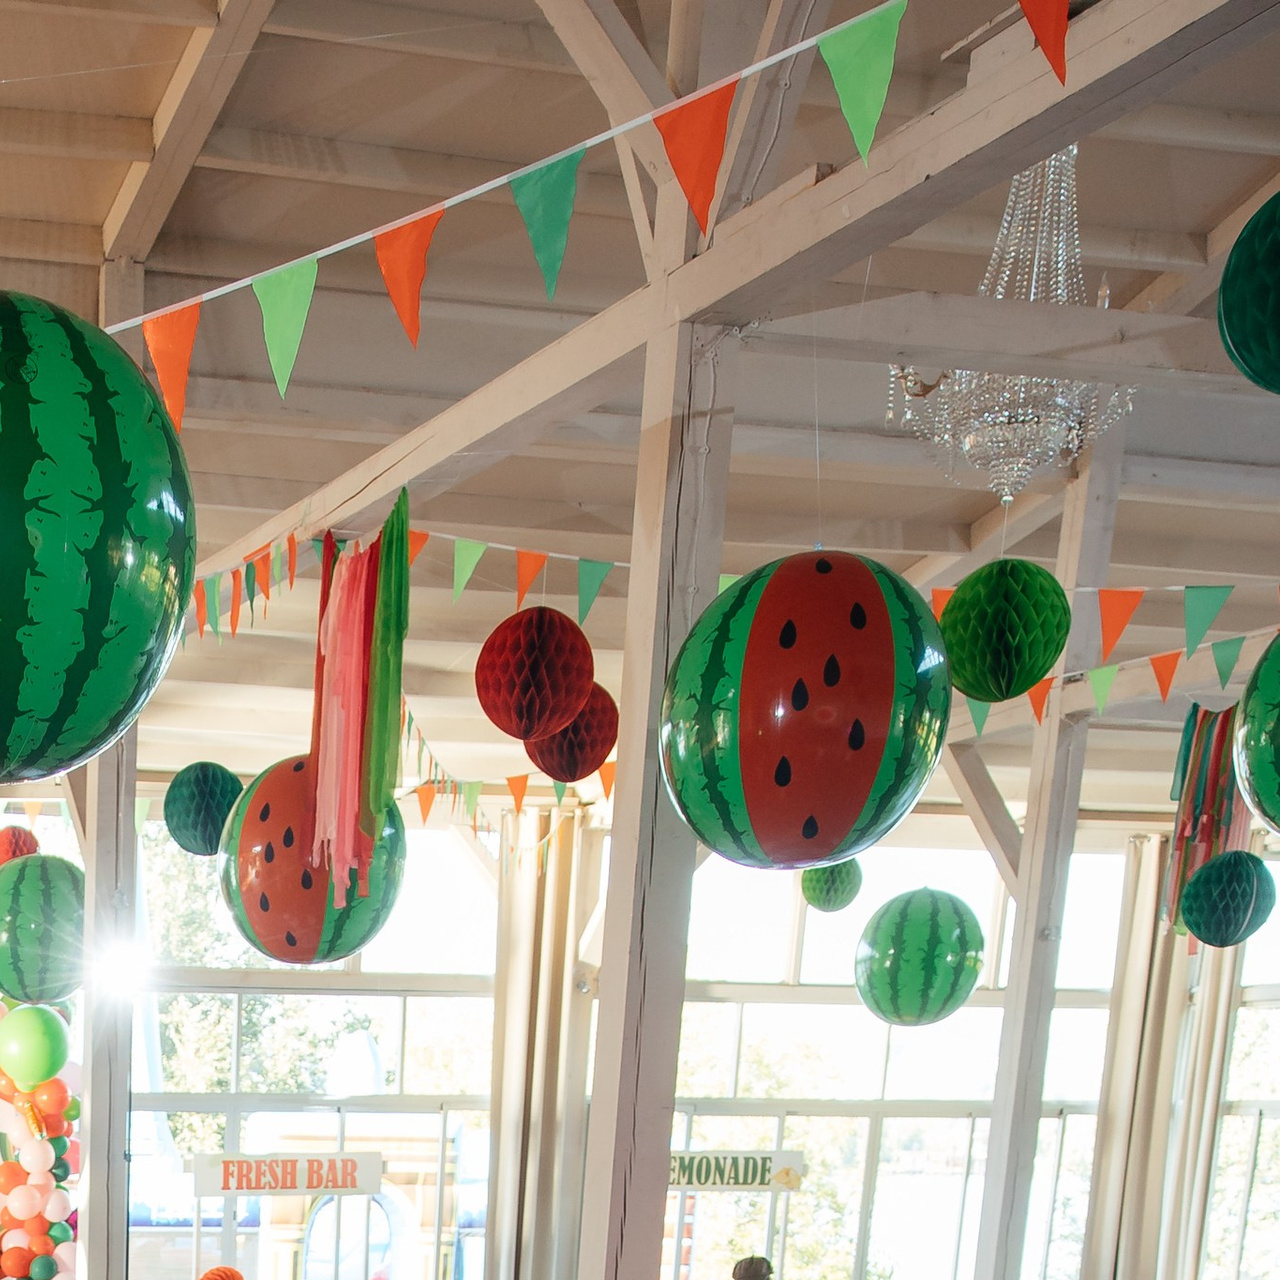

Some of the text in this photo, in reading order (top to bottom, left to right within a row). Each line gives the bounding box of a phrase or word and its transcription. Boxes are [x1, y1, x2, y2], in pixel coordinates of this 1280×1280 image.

[221, 1158, 358, 1191] FRESH BAR
[669, 1155, 773, 1186] EMONADE
